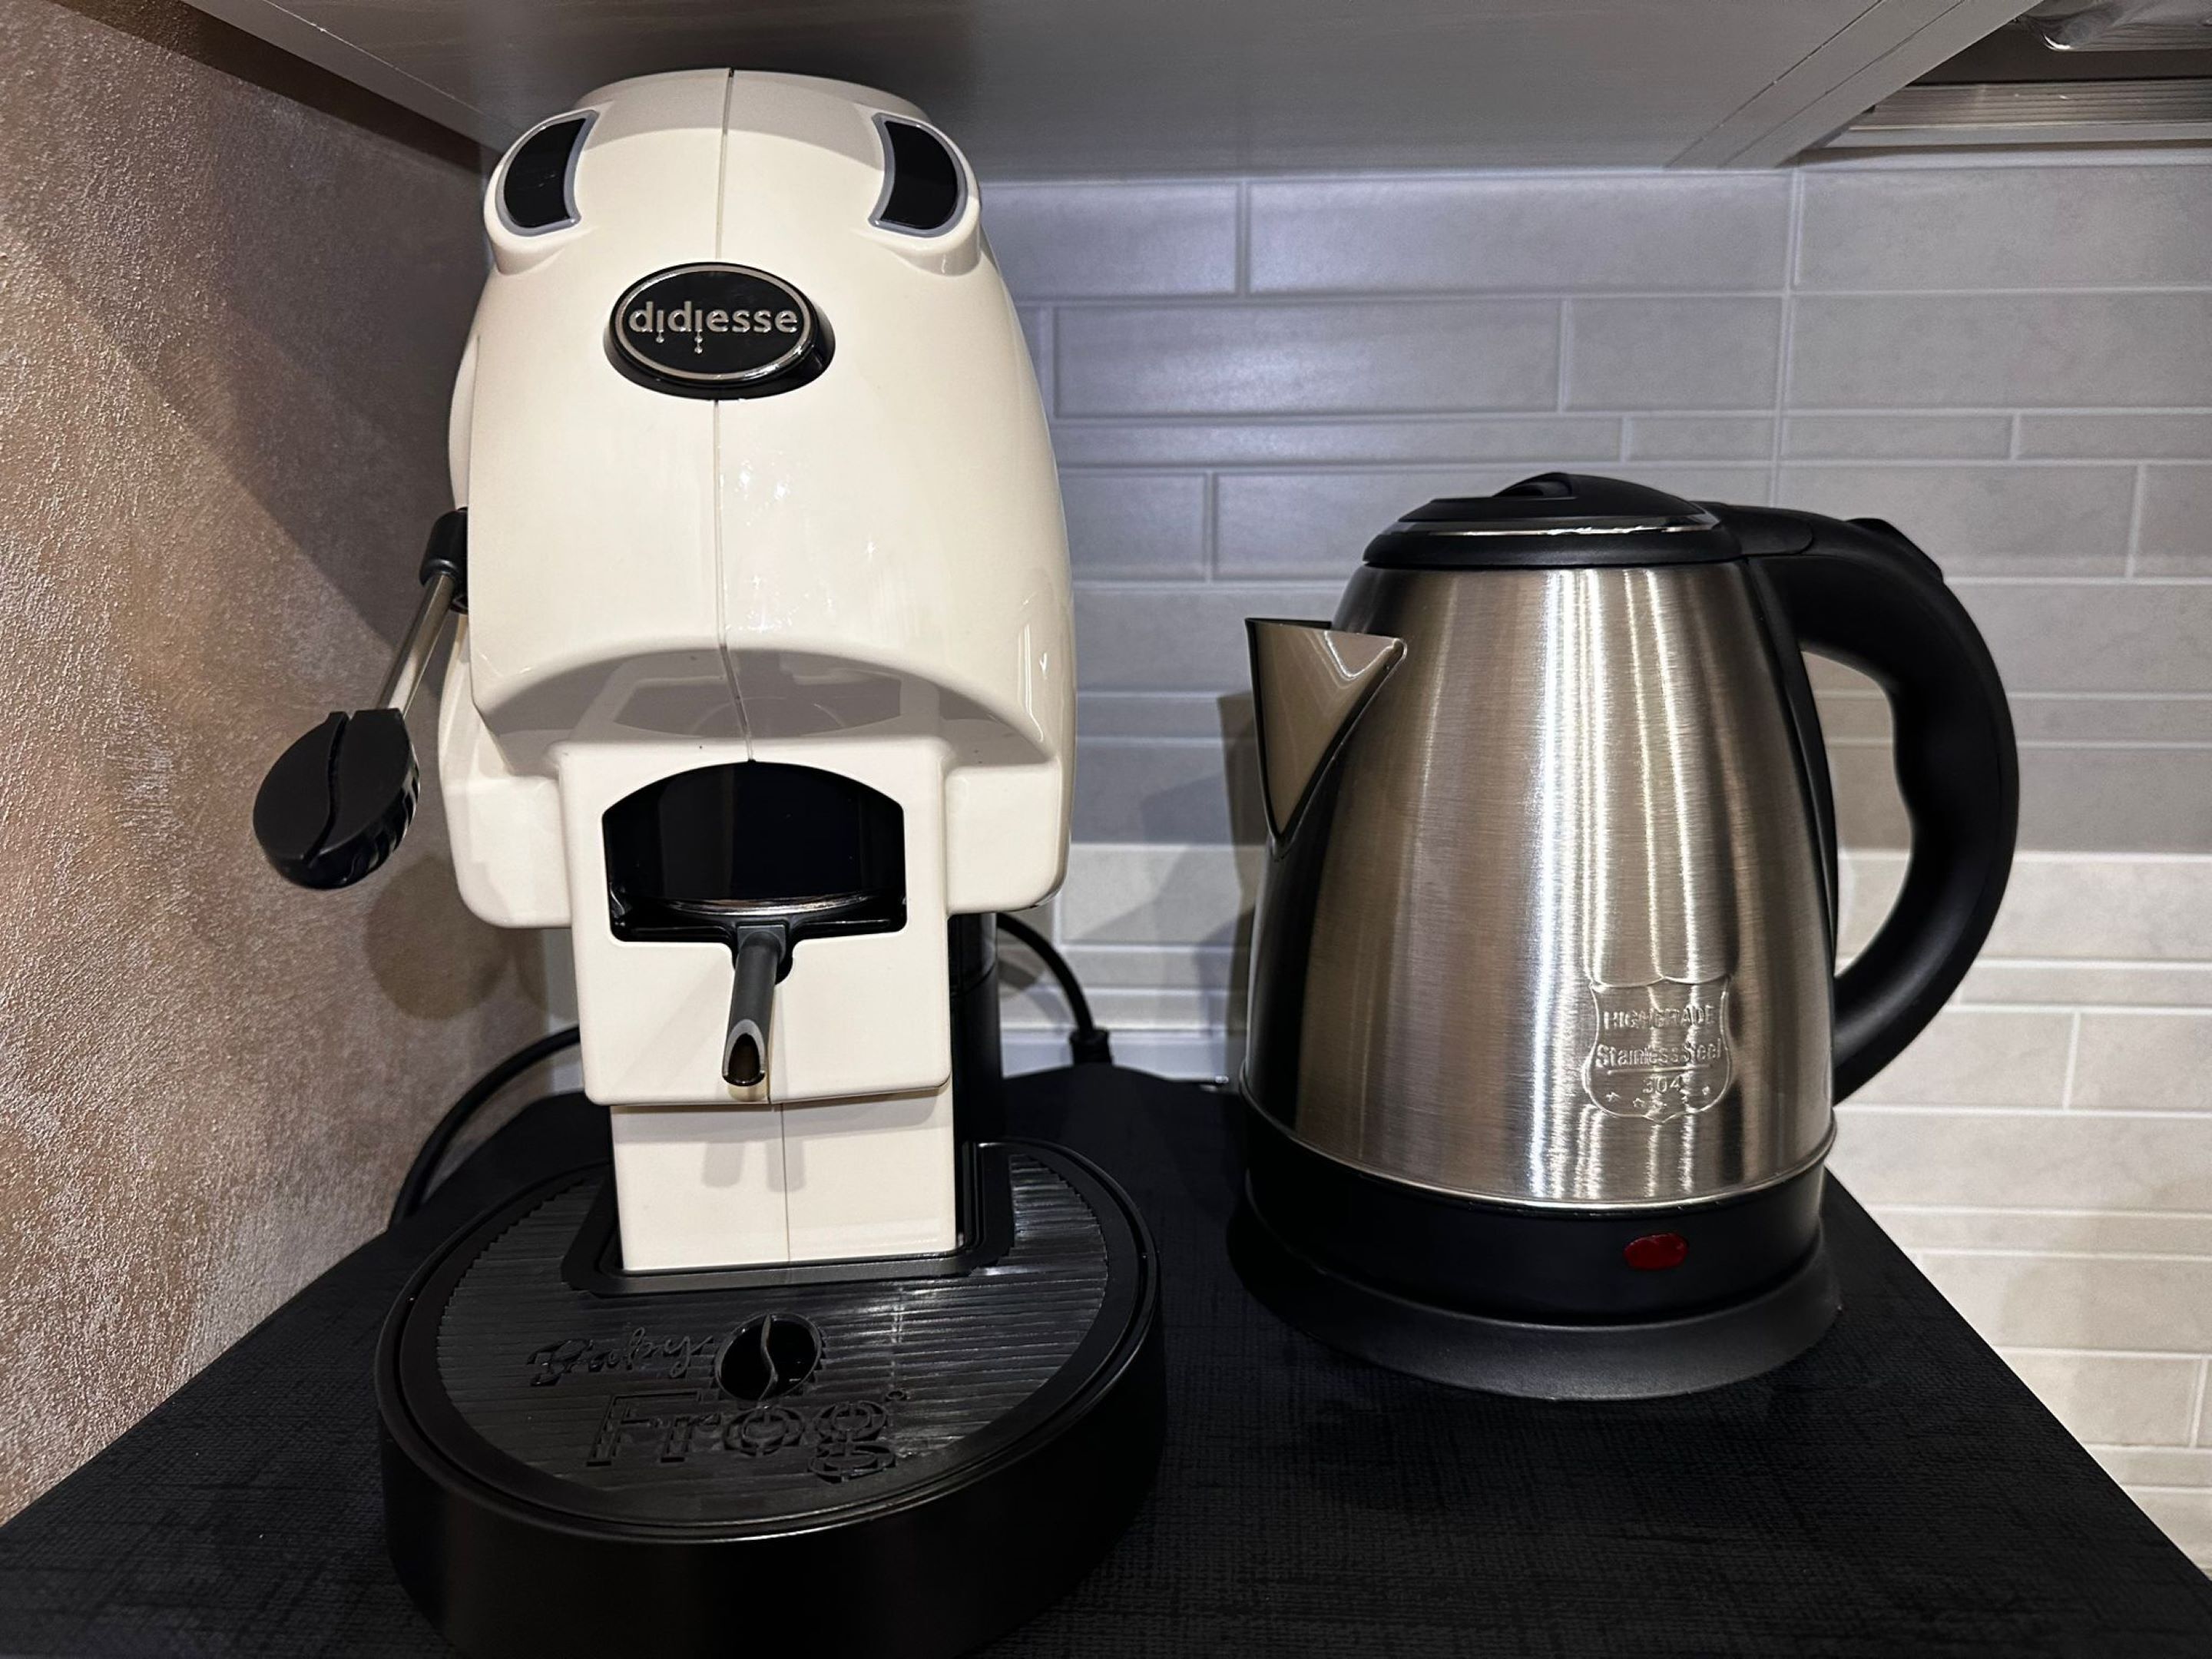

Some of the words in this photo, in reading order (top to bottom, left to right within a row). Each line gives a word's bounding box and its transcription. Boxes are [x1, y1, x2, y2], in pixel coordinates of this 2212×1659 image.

[628, 300, 798, 354] didiesse
[1595, 1043, 1680, 1068] Stainless
[1682, 1037, 1722, 1065] Steel
[1642, 1075, 1682, 1094] 304
[526, 1326, 715, 1386] Baby
[585, 1389, 908, 1483] Frog
